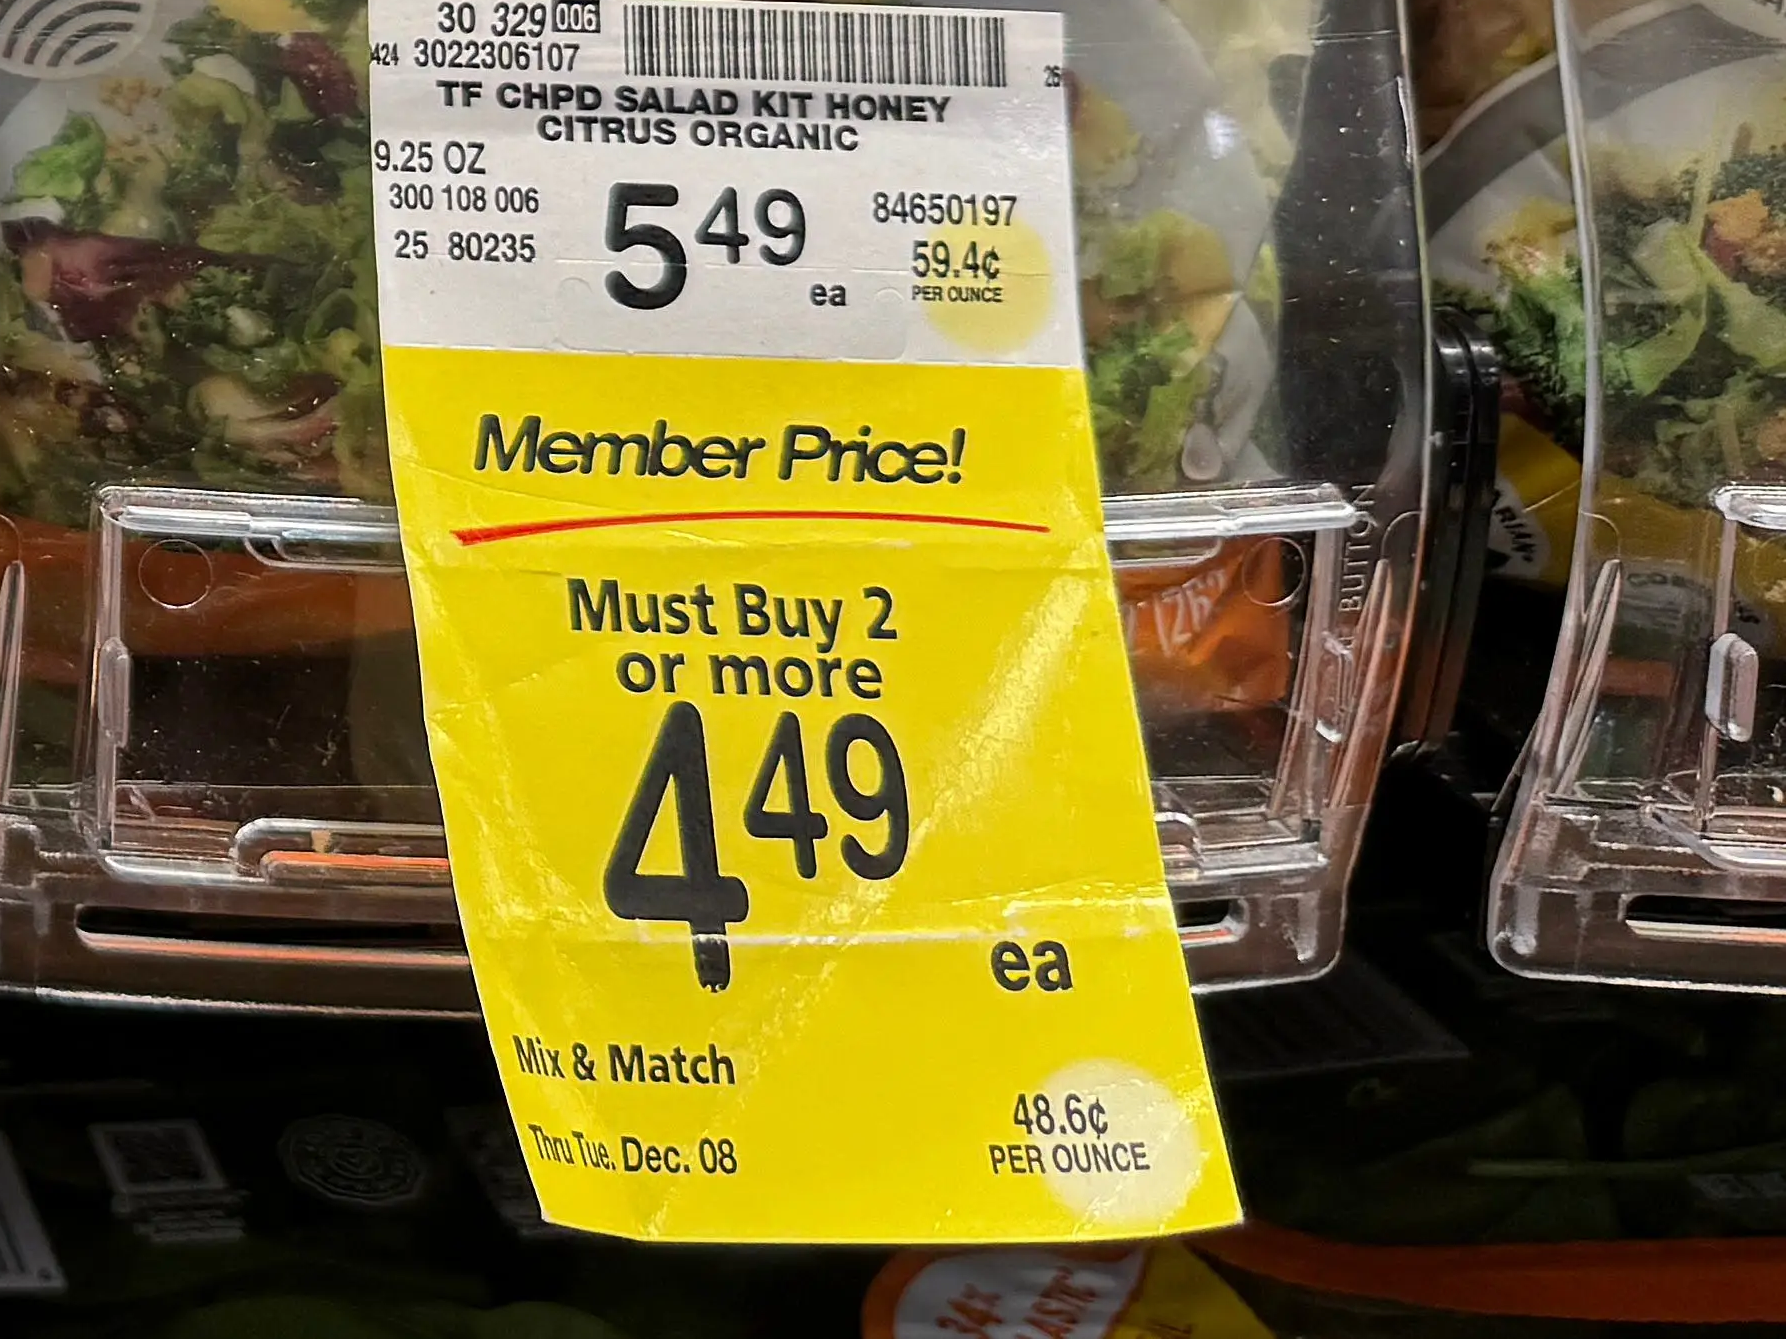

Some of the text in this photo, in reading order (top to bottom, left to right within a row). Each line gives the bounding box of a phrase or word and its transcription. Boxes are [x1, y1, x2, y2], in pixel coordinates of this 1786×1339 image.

[414, 42, 579, 72] 3022306107
[437, 81, 950, 122] TF CHPD SALAD KIT HONEY
[537, 117, 858, 152] CITRUS ORGANIC
[871, 192, 1017, 225] 84650197
[910, 241, 1000, 279] 59.4¢
[473, 414, 965, 484] Member Price!
[1013, 1093, 1109, 1137] 48.6¢
